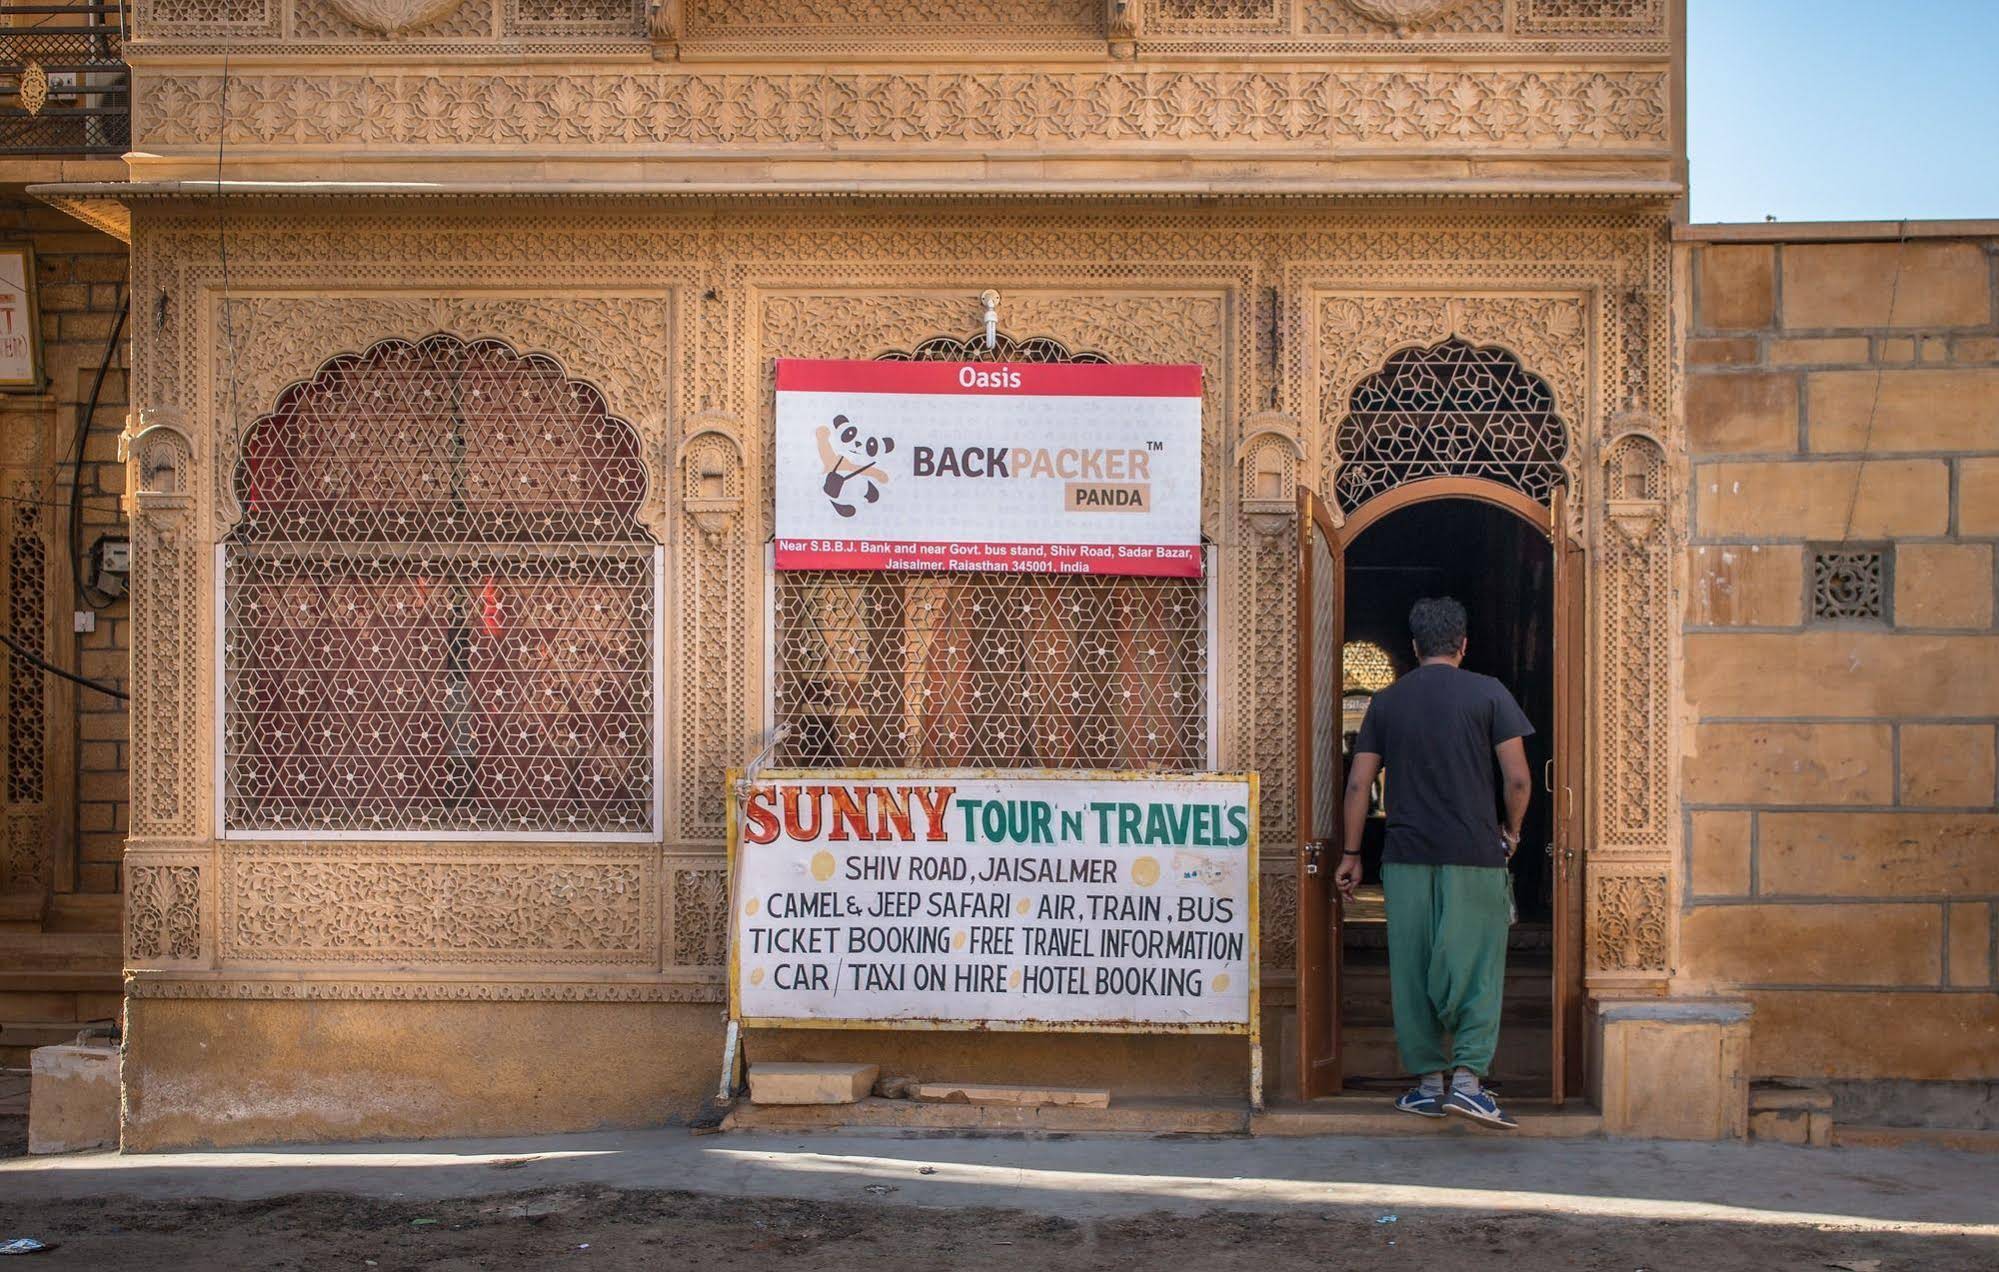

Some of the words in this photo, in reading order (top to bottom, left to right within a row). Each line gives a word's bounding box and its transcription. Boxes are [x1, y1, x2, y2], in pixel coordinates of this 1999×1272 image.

[958, 366, 1022, 388] Oasis
[913, 446, 1150, 480] BACKPACKER
[1075, 488, 1143, 507] PANDA
[779, 539, 807, 551] Near
[810, 541, 857, 553] S.B.B.J.
[860, 542, 890, 554] Bank
[894, 543, 917, 555] and
[920, 545, 946, 555] near
[949, 543, 981, 556] Govt.
[984, 544, 1007, 556] bus
[1010, 545, 1047, 558] stand,
[1050, 545, 1077, 557] Shiv
[1080, 546, 1114, 559] Road,
[1118, 547, 1153, 558] Sadar
[1156, 547, 1193, 560] Bazar,
[1060, 561, 1090, 573] India
[744, 785, 956, 844] SUNNY
[956, 799, 1055, 844] TOUR
[845, 856, 901, 881] SHIV
[978, 857, 1118, 883] JAISALMER
[767, 892, 844, 918] CAMEL
[868, 892, 921, 918] JEEP
[926, 892, 1011, 918] SAFARI
[1037, 894, 1083, 923] AIR,
[1177, 896, 1234, 923] BUS
[749, 927, 840, 953] TICKET
[848, 926, 950, 953] BOOKING
[969, 926, 1014, 954] FREE
[1022, 927, 1094, 957] TRAVEL
[1100, 928, 1243, 960] INFORMATION
[848, 963, 905, 990] TAXI
[913, 963, 946, 991] ON
[955, 963, 1007, 993] HIRE
[1022, 965, 1089, 995] HOTEL
[1095, 967, 1202, 997] BOOKING
